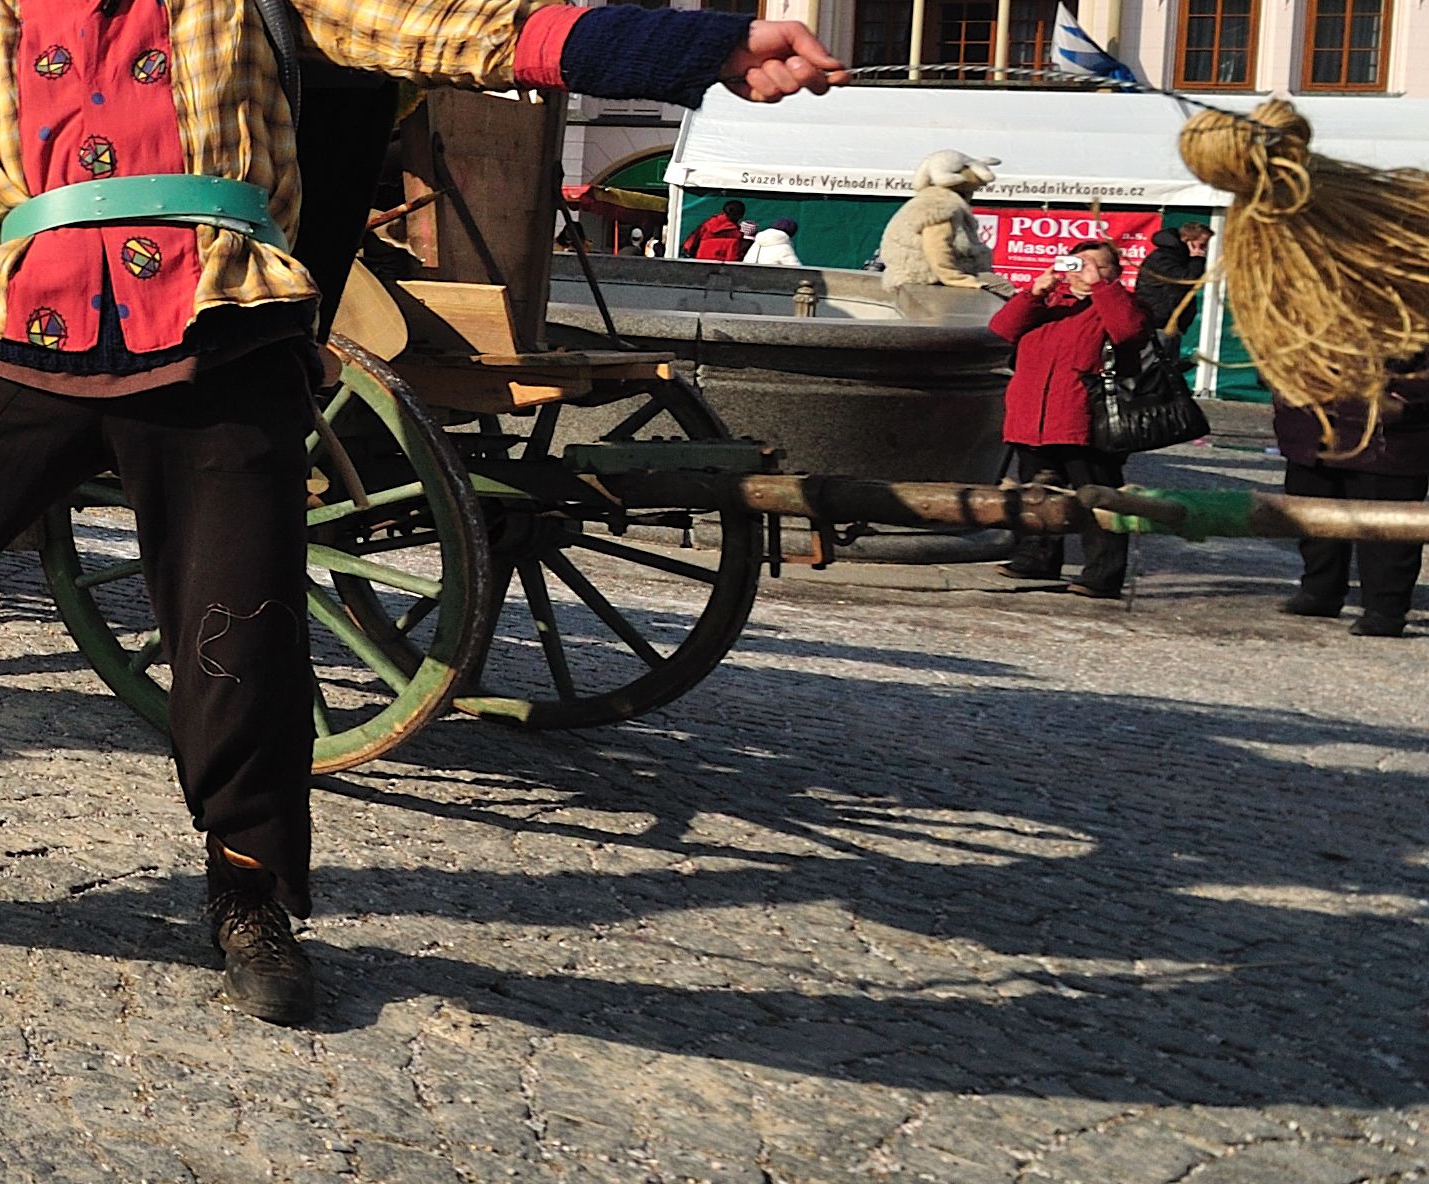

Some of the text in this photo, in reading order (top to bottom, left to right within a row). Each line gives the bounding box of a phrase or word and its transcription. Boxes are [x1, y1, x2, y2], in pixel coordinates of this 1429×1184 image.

[741, 172, 783, 185] Svazek
[788, 174, 817, 187] obcí
[820, 175, 880, 191] Východní
